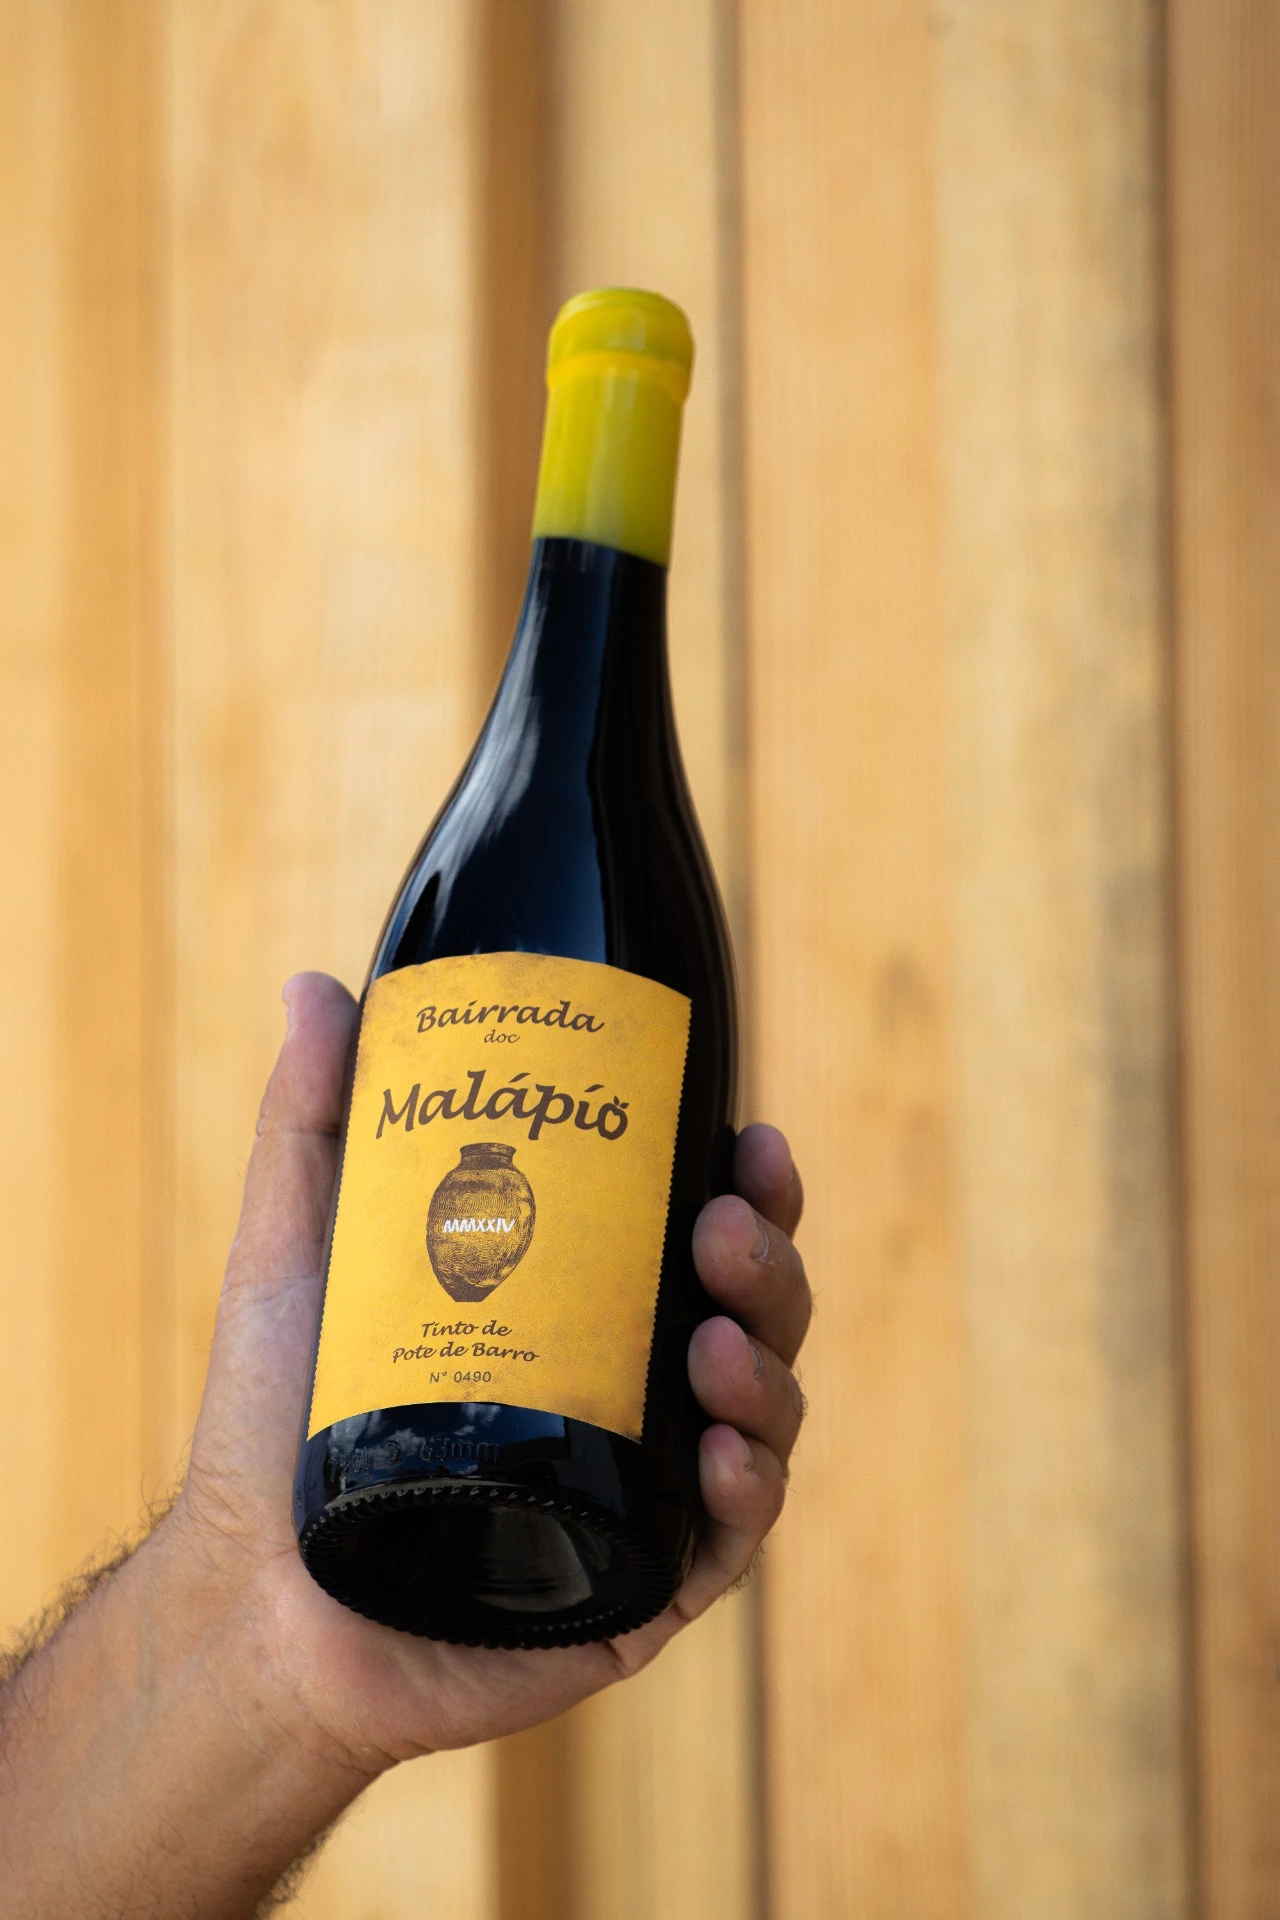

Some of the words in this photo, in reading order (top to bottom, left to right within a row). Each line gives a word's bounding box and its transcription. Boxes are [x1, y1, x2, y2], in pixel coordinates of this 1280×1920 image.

[483, 1029, 520, 1044] doc
[443, 1218, 516, 1234] MMXXIV
[481, 1319, 513, 1337] de
[392, 1345, 437, 1363] Pote
[439, 1341, 470, 1358] de
[471, 1342, 540, 1363] Barro
[453, 1370, 492, 1383] 0490
